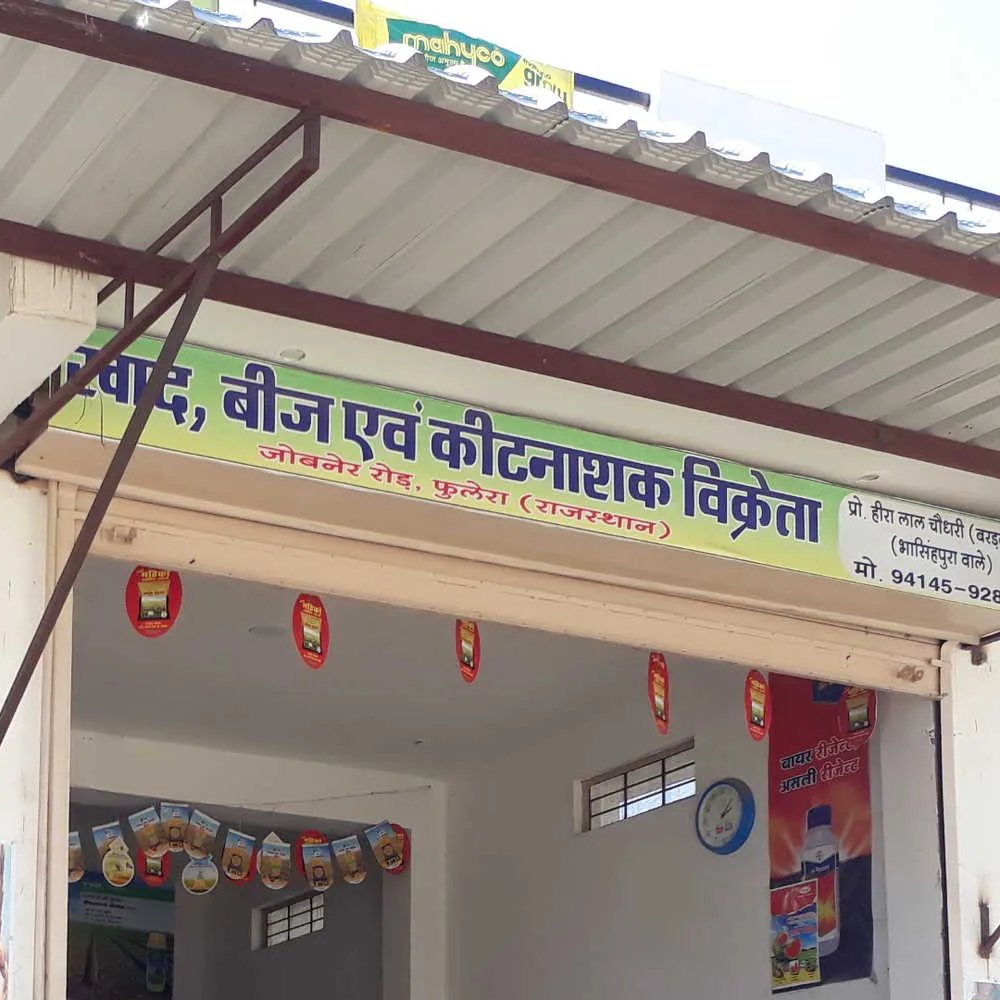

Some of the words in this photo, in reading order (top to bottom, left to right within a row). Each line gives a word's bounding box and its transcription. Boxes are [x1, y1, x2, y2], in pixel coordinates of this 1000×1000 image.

[402, 31, 505, 67] mahyco
[220, 362, 336, 445] बीज
[342, 399, 422, 463] एवं
[428, 408, 674, 510] कीटनाशक
[682, 456, 824, 545] विक्रेता
[257, 442, 362, 479] जोबनेर
[432, 477, 511, 507] फुलेरा
[518, 493, 673, 541] (राजस्थान)
[847, 495, 867, 520] प्रो.
[871, 500, 894, 525] हीरा
[897, 511, 926, 531] लाल
[928, 513, 965, 540] चौधरी
[853, 556, 884, 583] मो.
[961, 549, 993, 576] वाले)
